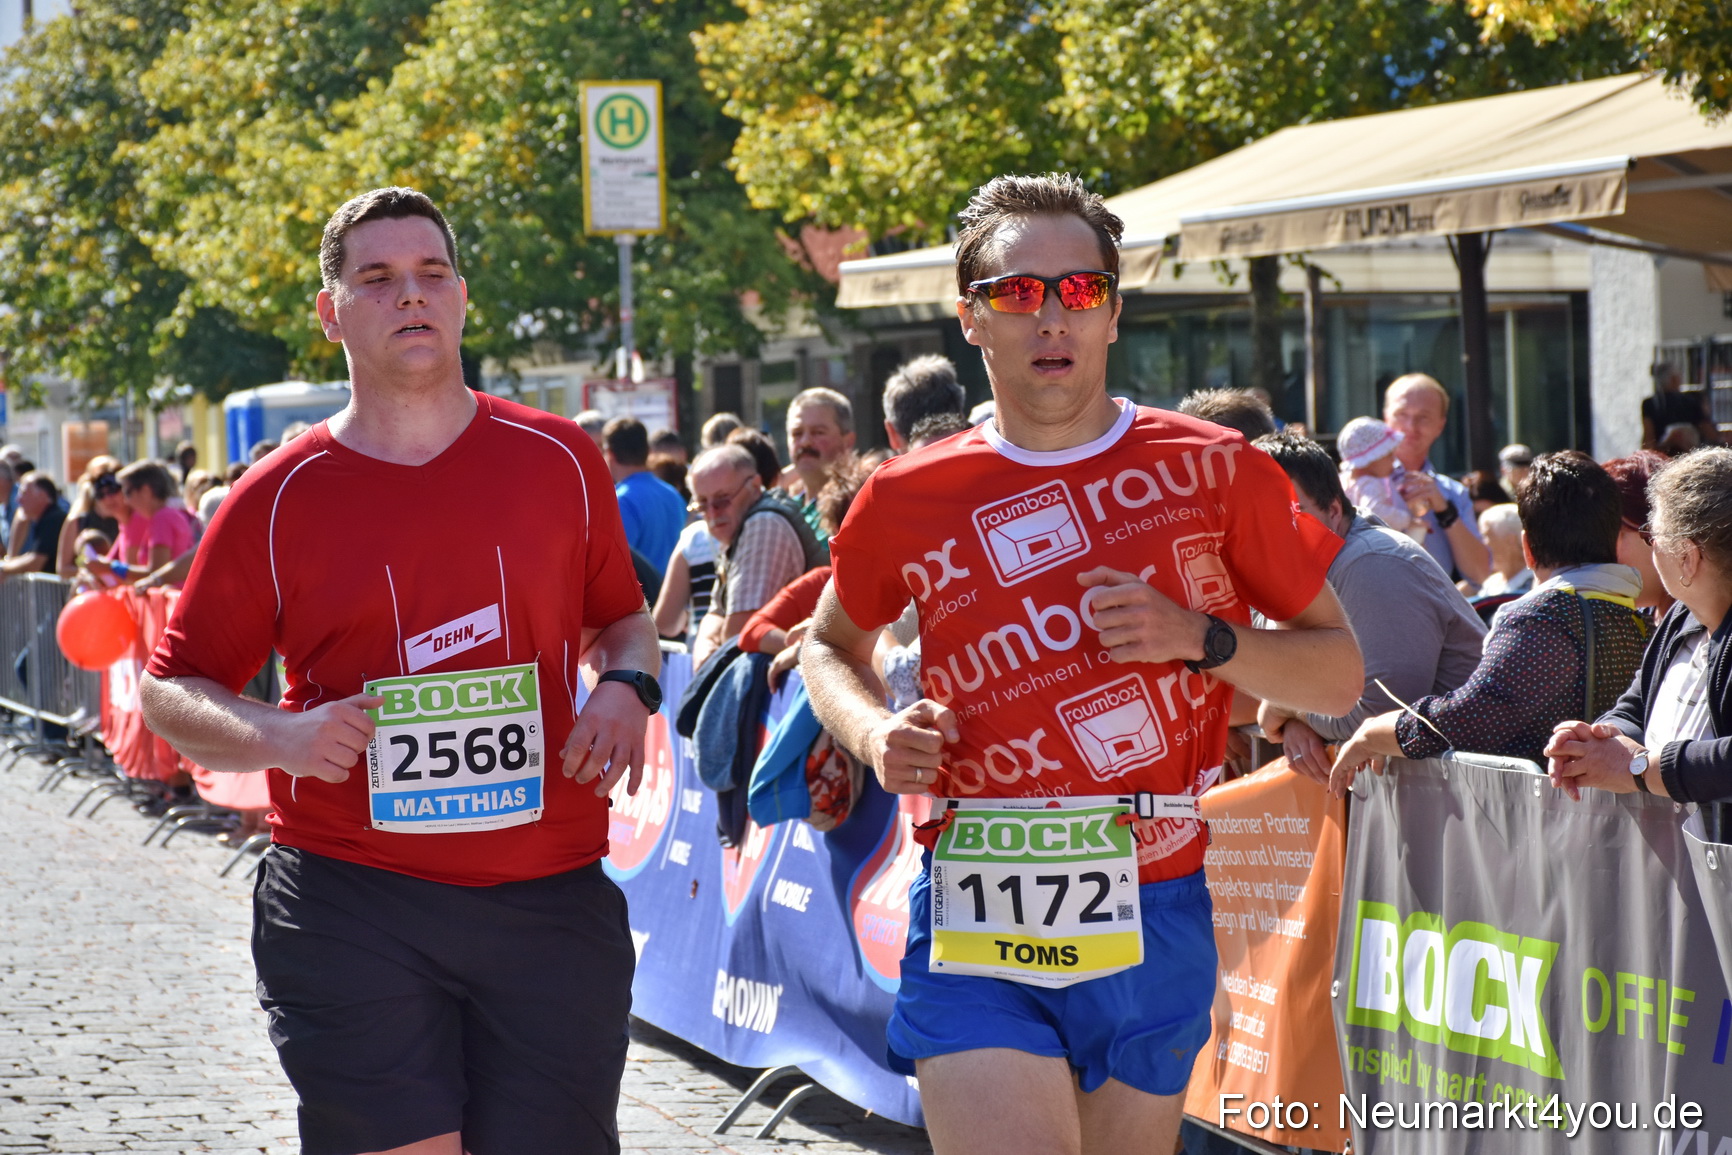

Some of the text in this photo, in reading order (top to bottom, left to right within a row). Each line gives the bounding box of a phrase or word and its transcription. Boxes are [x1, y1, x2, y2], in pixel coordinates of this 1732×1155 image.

[981, 489, 1063, 530] raumbox
[1104, 507, 1204, 545] schenken
[433, 623, 475, 653] DEHN
[381, 674, 522, 717] BOCK
[1003, 662, 1081, 702] wohnen
[1065, 684, 1141, 723] raumbox
[390, 724, 537, 782] 2568 C
[393, 786, 527, 817] MATTHIAS
[953, 820, 1110, 853] BOCK
[1207, 812, 1263, 834] moderner
[1264, 812, 1310, 834] Partner
[1245, 844, 1269, 866] und
[957, 871, 1129, 927] 1172 A
[1252, 882, 1275, 899] was
[1238, 908, 1257, 931] und
[995, 940, 1080, 967] TOMS
[1355, 918, 1546, 1058] BOCK
[1417, 1052, 1432, 1099] by
